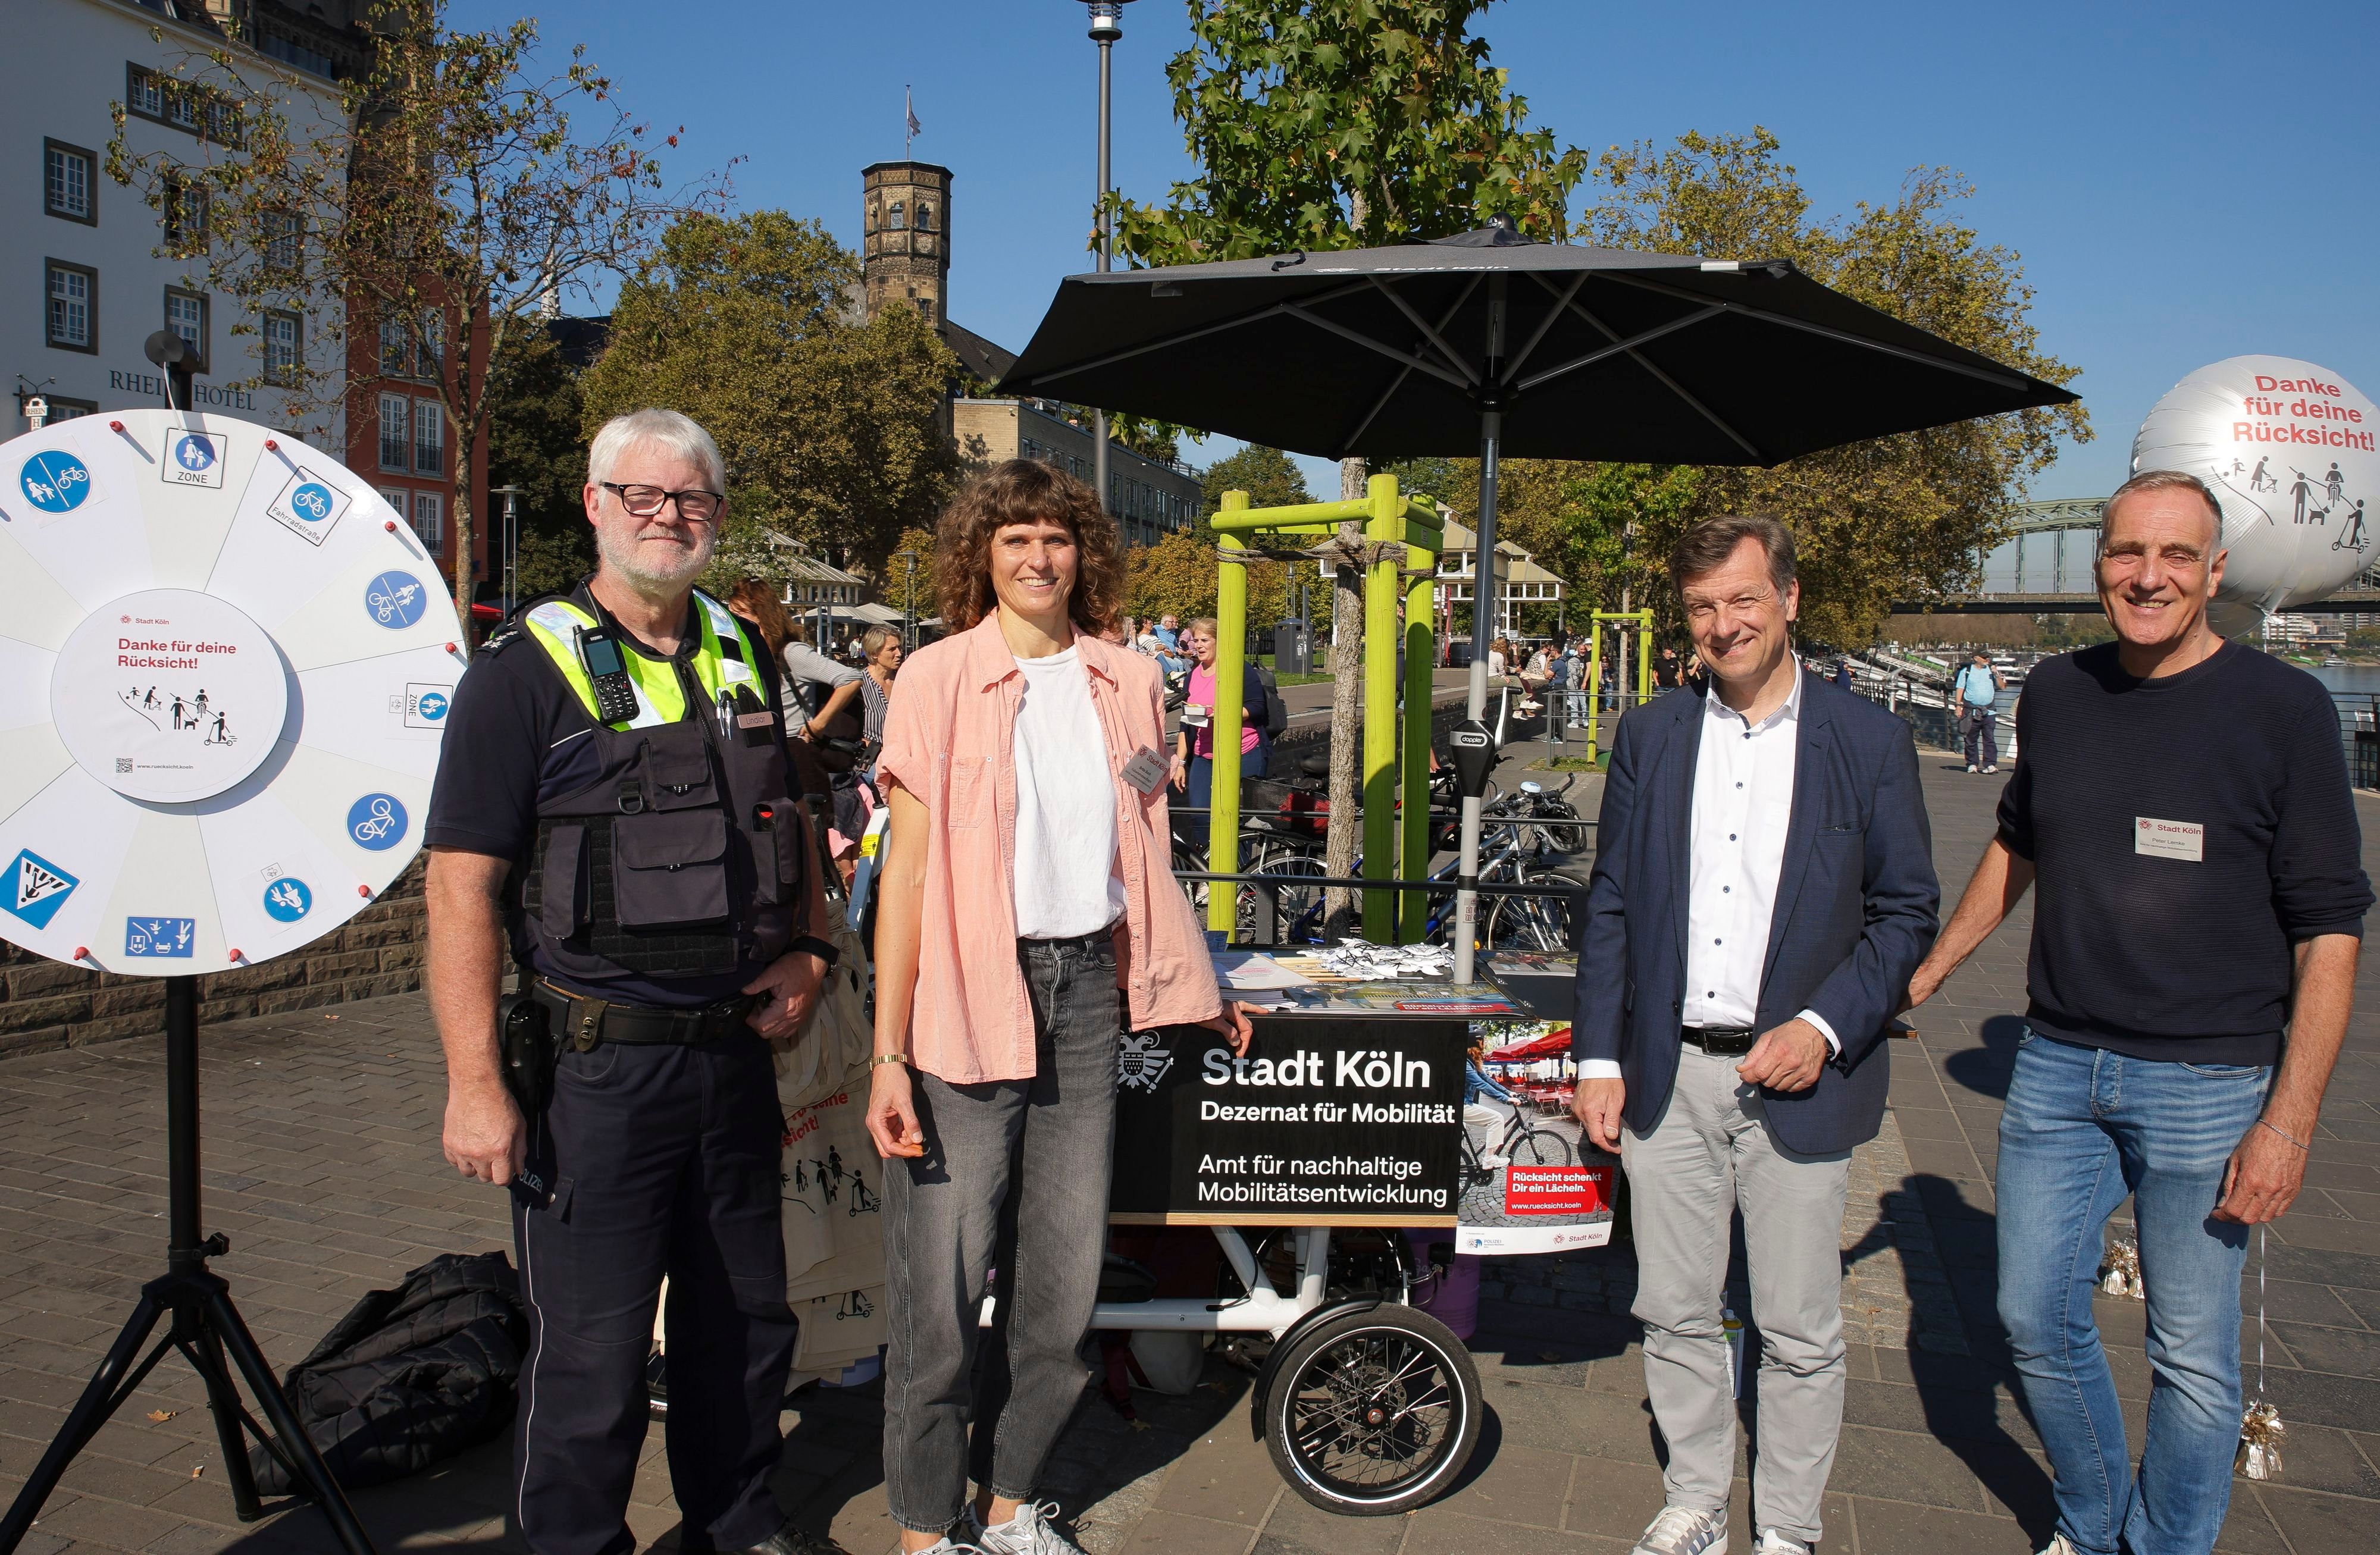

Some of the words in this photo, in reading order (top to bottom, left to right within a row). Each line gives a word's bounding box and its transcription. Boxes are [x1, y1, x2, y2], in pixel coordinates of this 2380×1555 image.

[109, 370, 165, 396] RHEI
[194, 384, 257, 411] HOTEL
[2255, 375, 2342, 398] Danke
[2243, 397, 2284, 416] für
[2291, 398, 2363, 424] deine
[2233, 422, 2375, 452] Rücksicht!
[177, 471, 208, 484] ZONE
[271, 507, 321, 541] Fahrradstraße
[118, 638, 168, 651] Danke
[171, 641, 192, 652] für
[195, 642, 237, 654] deine
[118, 655, 198, 669] Rücksicht!
[408, 694, 418, 717] ZONE
[746, 716, 766, 725] Lindlar
[1147, 755, 1158, 767] Stadt
[2157, 824, 2181, 833] Stadt
[2182, 827, 2202, 835] Köln
[1202, 1049, 1324, 1088] Stadt
[1336, 1049, 1430, 1088] Köln
[1201, 1101, 1308, 1123] Dezernat
[1313, 1102, 1348, 1123] für
[1352, 1103, 1455, 1124] Mobilität
[1198, 1154, 1247, 1175] Amt
[1252, 1155, 1285, 1175] für
[1291, 1155, 1422, 1181] nachhaltige
[1512, 1172, 1562, 1182] Rücksicht
[1563, 1172, 1602, 1182] schenkt
[1198, 1181, 1447, 1208] Mobilitätsentwicklung
[1512, 1183, 1529, 1192] Dir
[1529, 1184, 1544, 1192] ein
[1545, 1183, 1586, 1192] Lächeln.
[1511, 1202, 1582, 1210] www.ruecksicht.koeln
